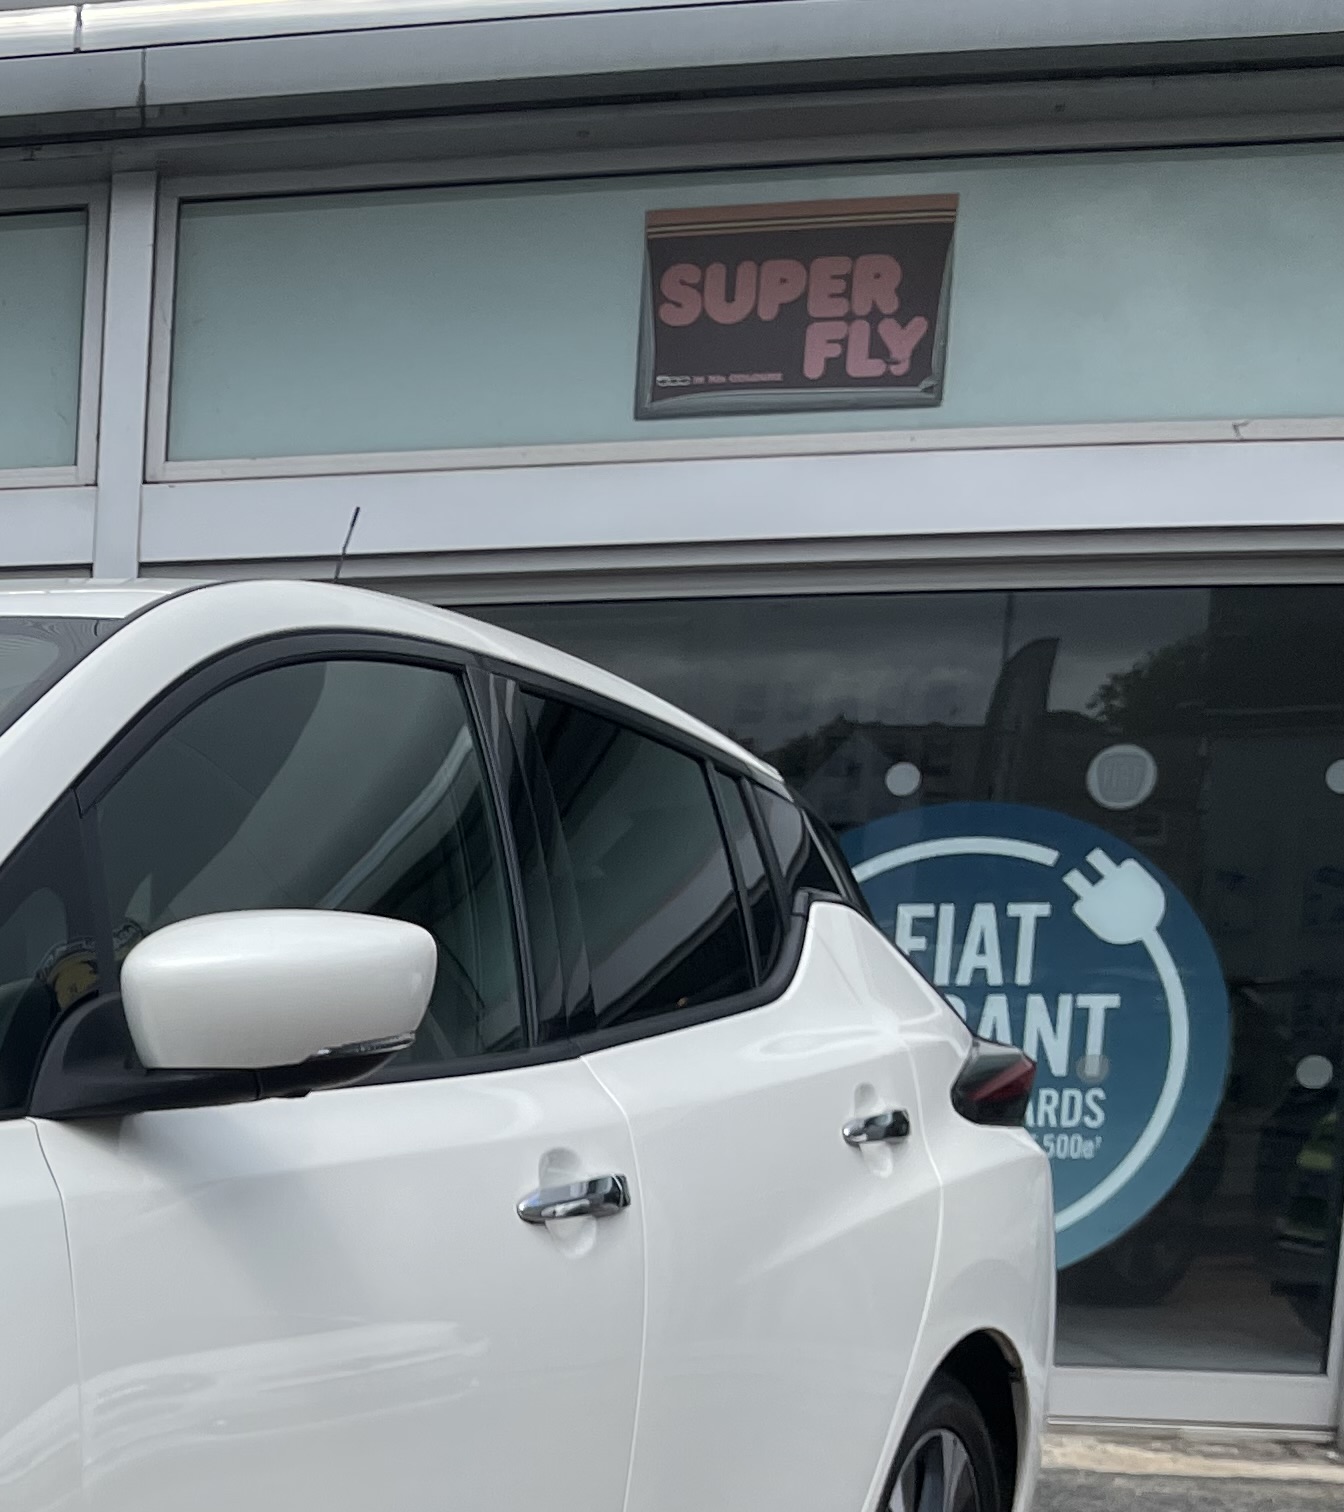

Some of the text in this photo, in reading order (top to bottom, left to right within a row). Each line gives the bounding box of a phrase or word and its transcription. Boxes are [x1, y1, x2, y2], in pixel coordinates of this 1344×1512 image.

[658, 254, 903, 327] SUPER
[803, 316, 929, 380] FLY
[895, 902, 1052, 987] FIAT
[944, 993, 1121, 1077] ANT
[1024, 1087, 1107, 1129] RDS
